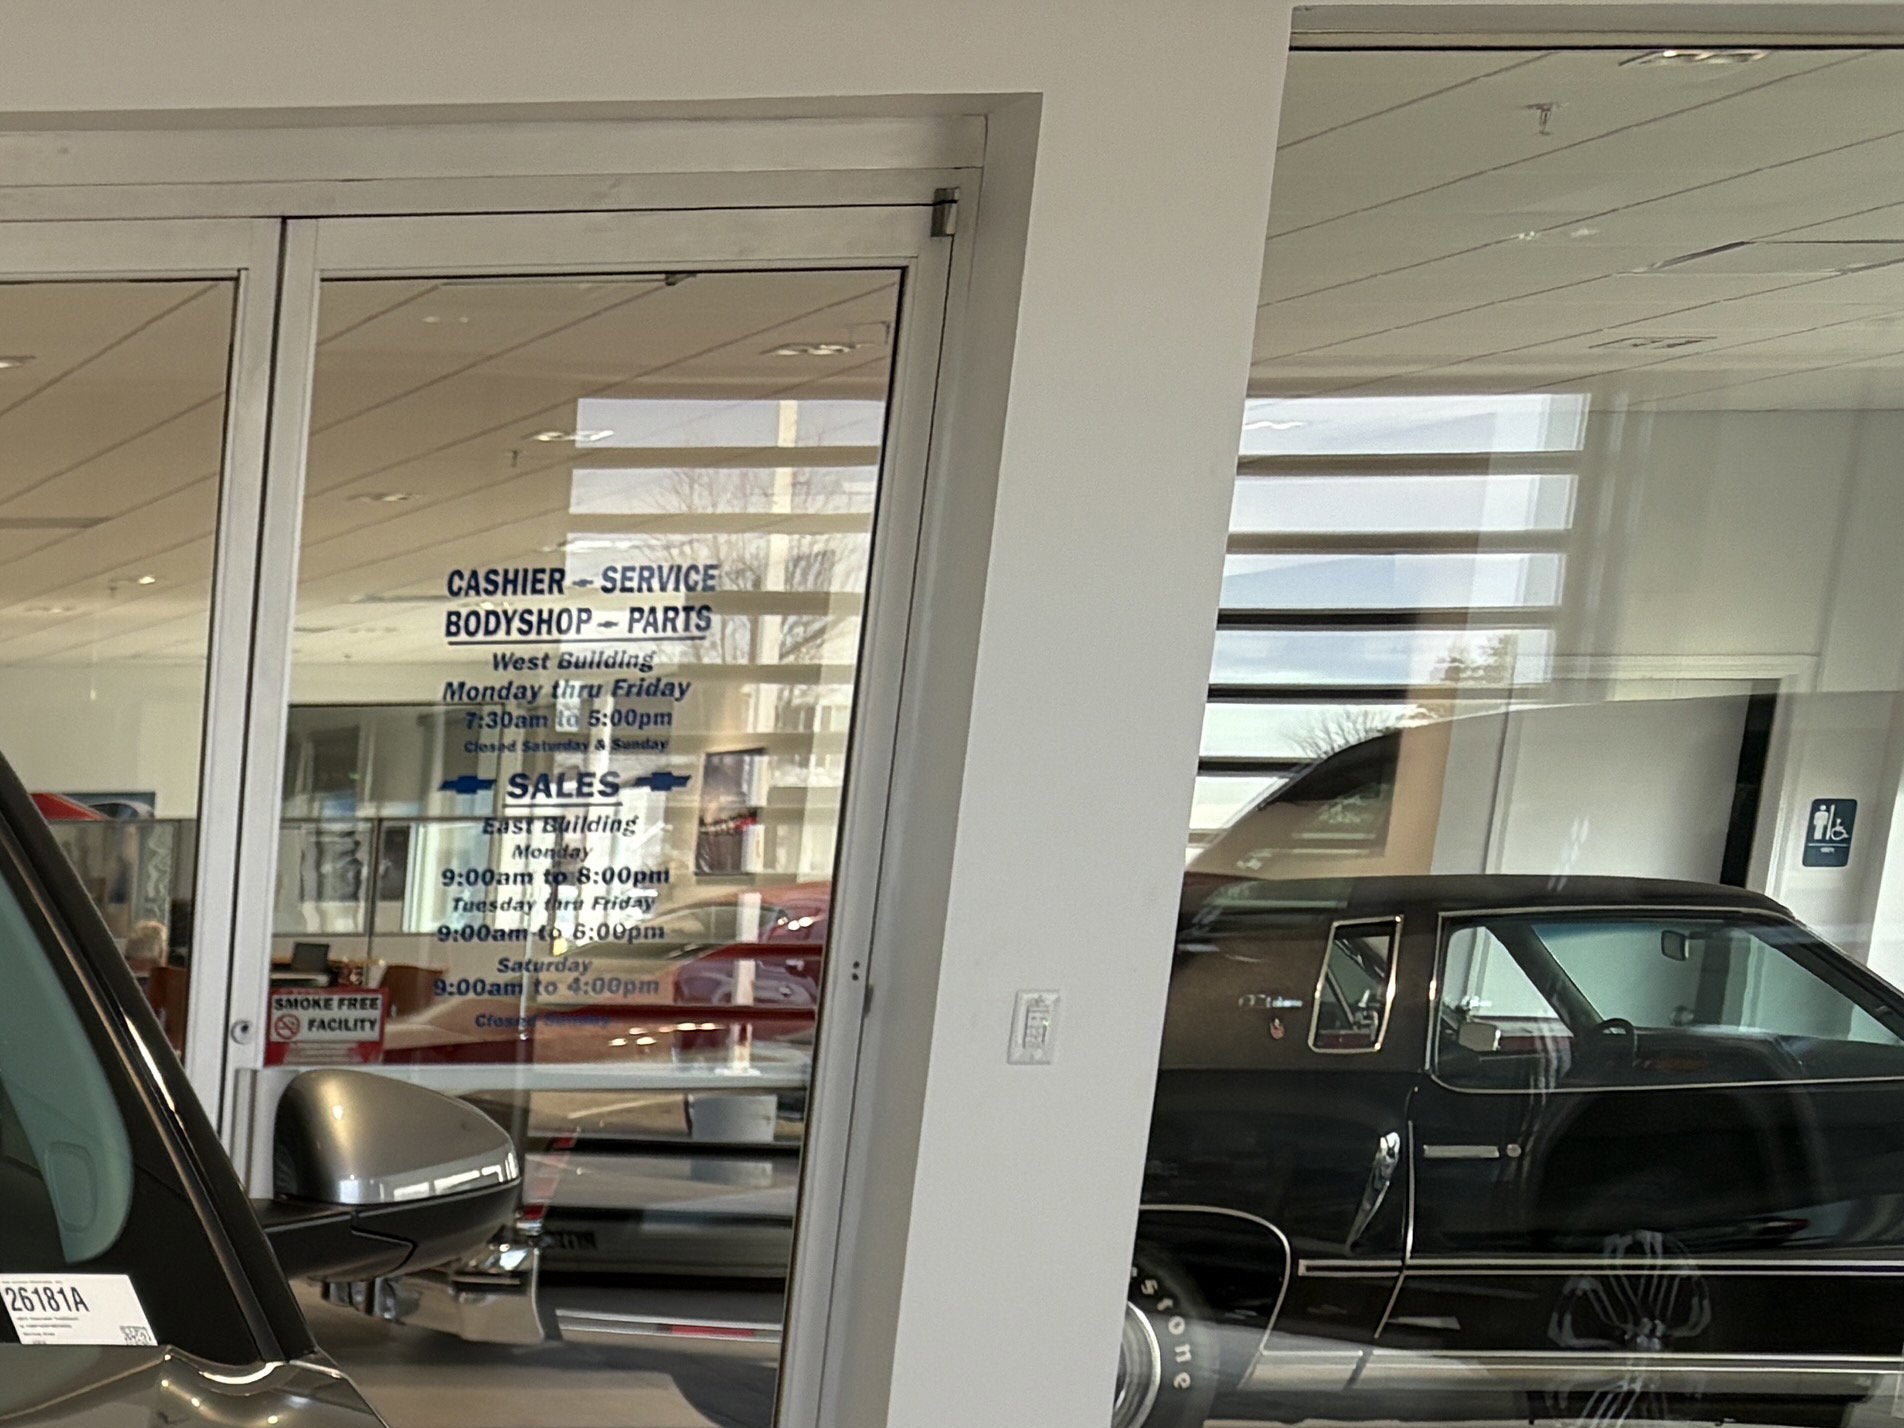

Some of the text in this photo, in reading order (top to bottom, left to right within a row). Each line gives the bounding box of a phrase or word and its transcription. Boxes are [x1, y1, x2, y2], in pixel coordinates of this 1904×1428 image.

[446, 563, 721, 597] CASHIER SERVICE
[445, 604, 713, 638] BODYSHOP PARTS
[492, 650, 658, 673] West Building
[442, 677, 693, 705] Monday thru Friday
[464, 708, 673, 730] 7:30am to 5:00pm
[464, 738, 669, 754] Closed Saturday & Sunday
[507, 771, 621, 799] SALES
[483, 814, 639, 836] East Building
[511, 844, 592, 863] Monday
[442, 866, 670, 887] 9:00am to 8:00pm
[452, 895, 655, 915] Tuesday thru Friday
[436, 924, 528, 943] 9:00am
[539, 924, 562, 941] to
[497, 956, 592, 975] Saturday
[434, 976, 660, 996] 9:00am to 4:00pm
[274, 997, 379, 1011] SMOKE FREE
[307, 1018, 377, 1032] FACILITY
[5, 1286, 90, 1313] 26181A
